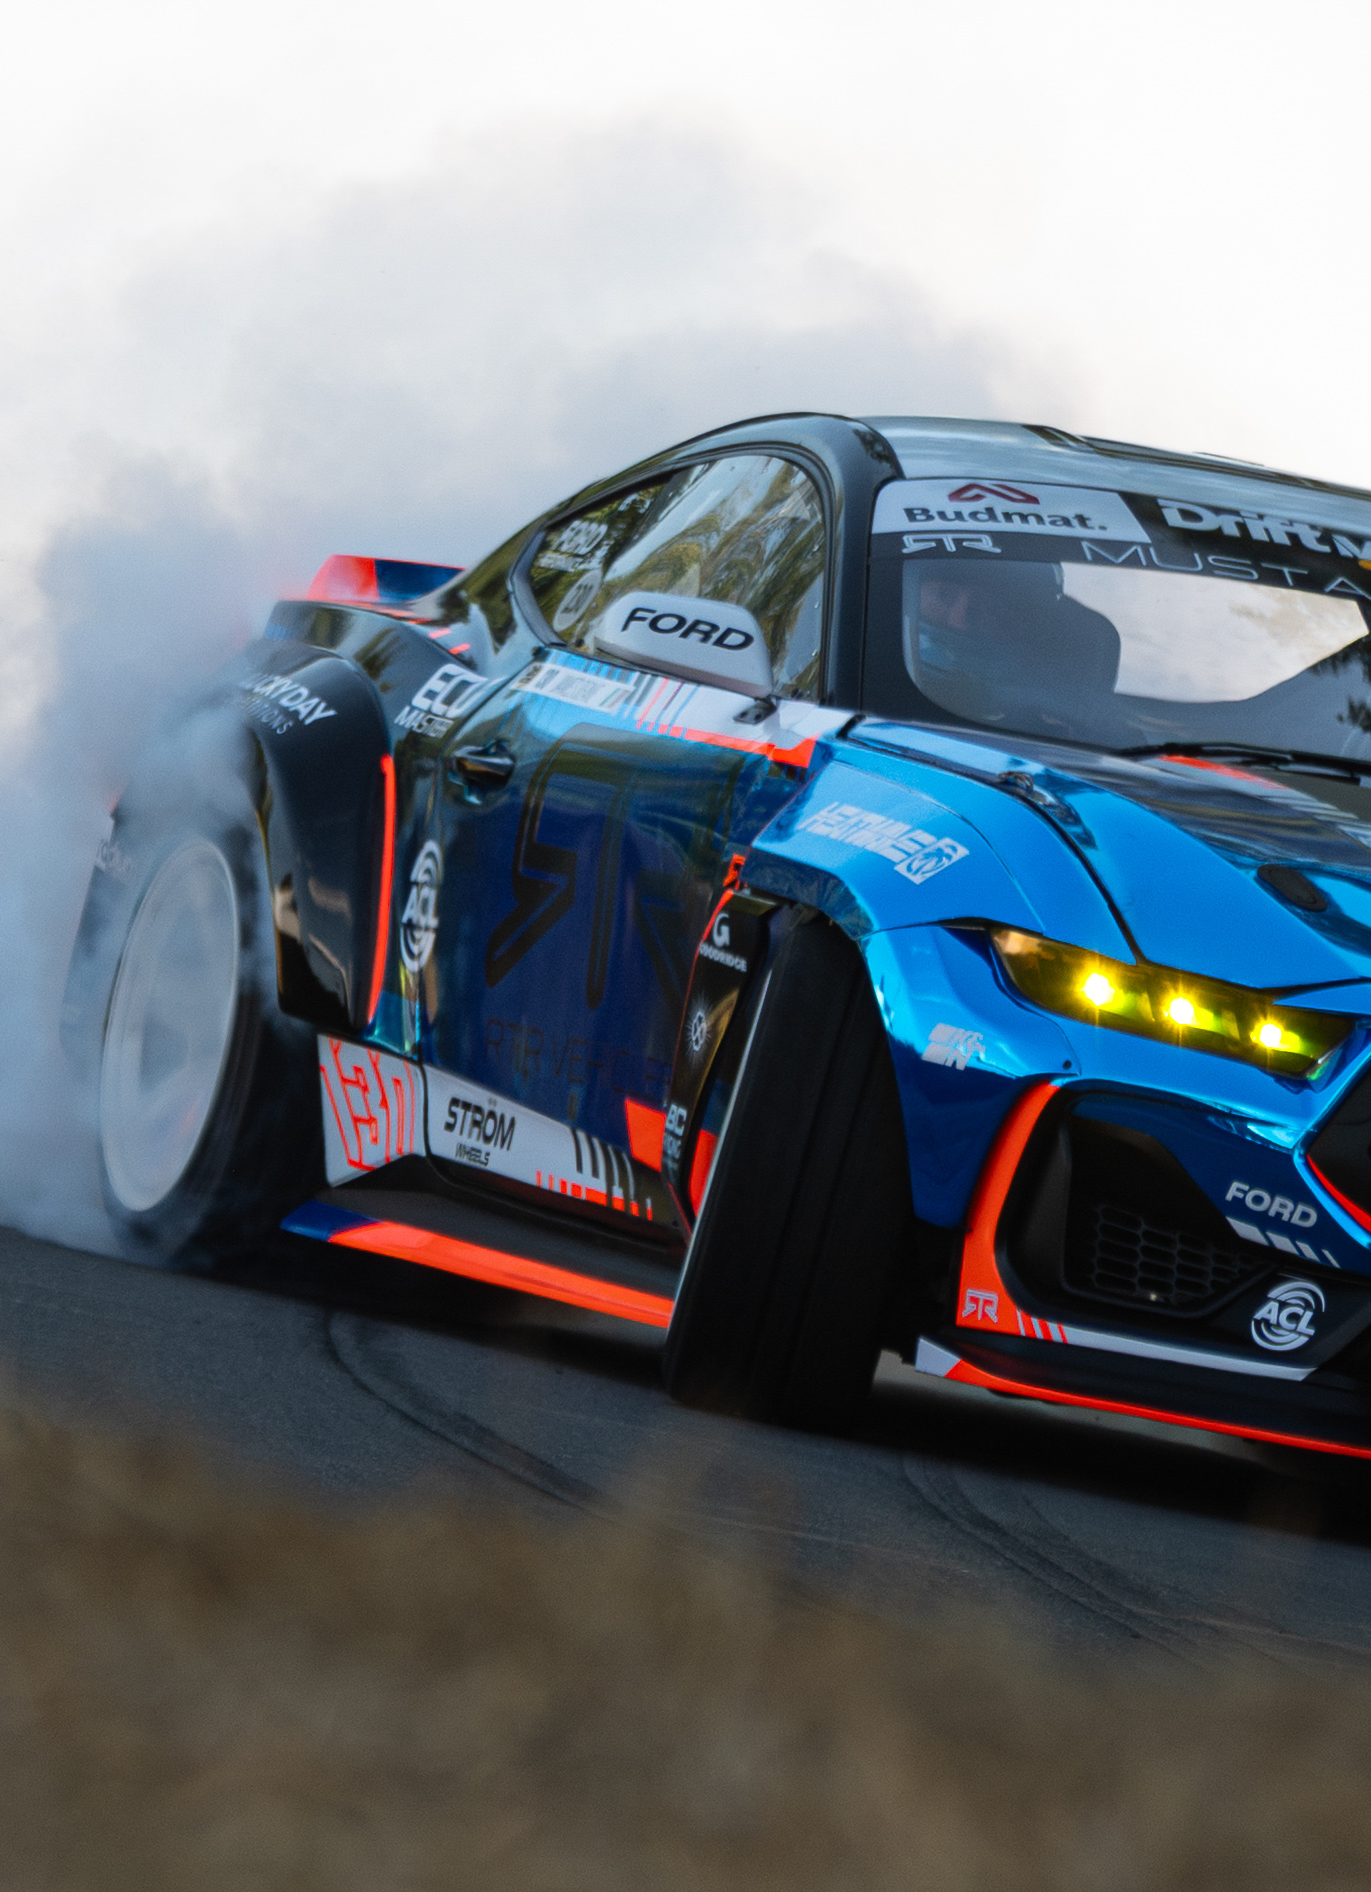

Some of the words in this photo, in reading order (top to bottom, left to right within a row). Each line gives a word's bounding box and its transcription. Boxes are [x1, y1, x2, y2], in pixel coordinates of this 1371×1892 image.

[903, 506, 1108, 532] Budmat.
[620, 606, 755, 651] FORD
[240, 674, 339, 727] CKYDAY
[454, 1142, 491, 1167] WHEELS
[1224, 1181, 1319, 1229] FORD
[1253, 1302, 1317, 1336] ACL
